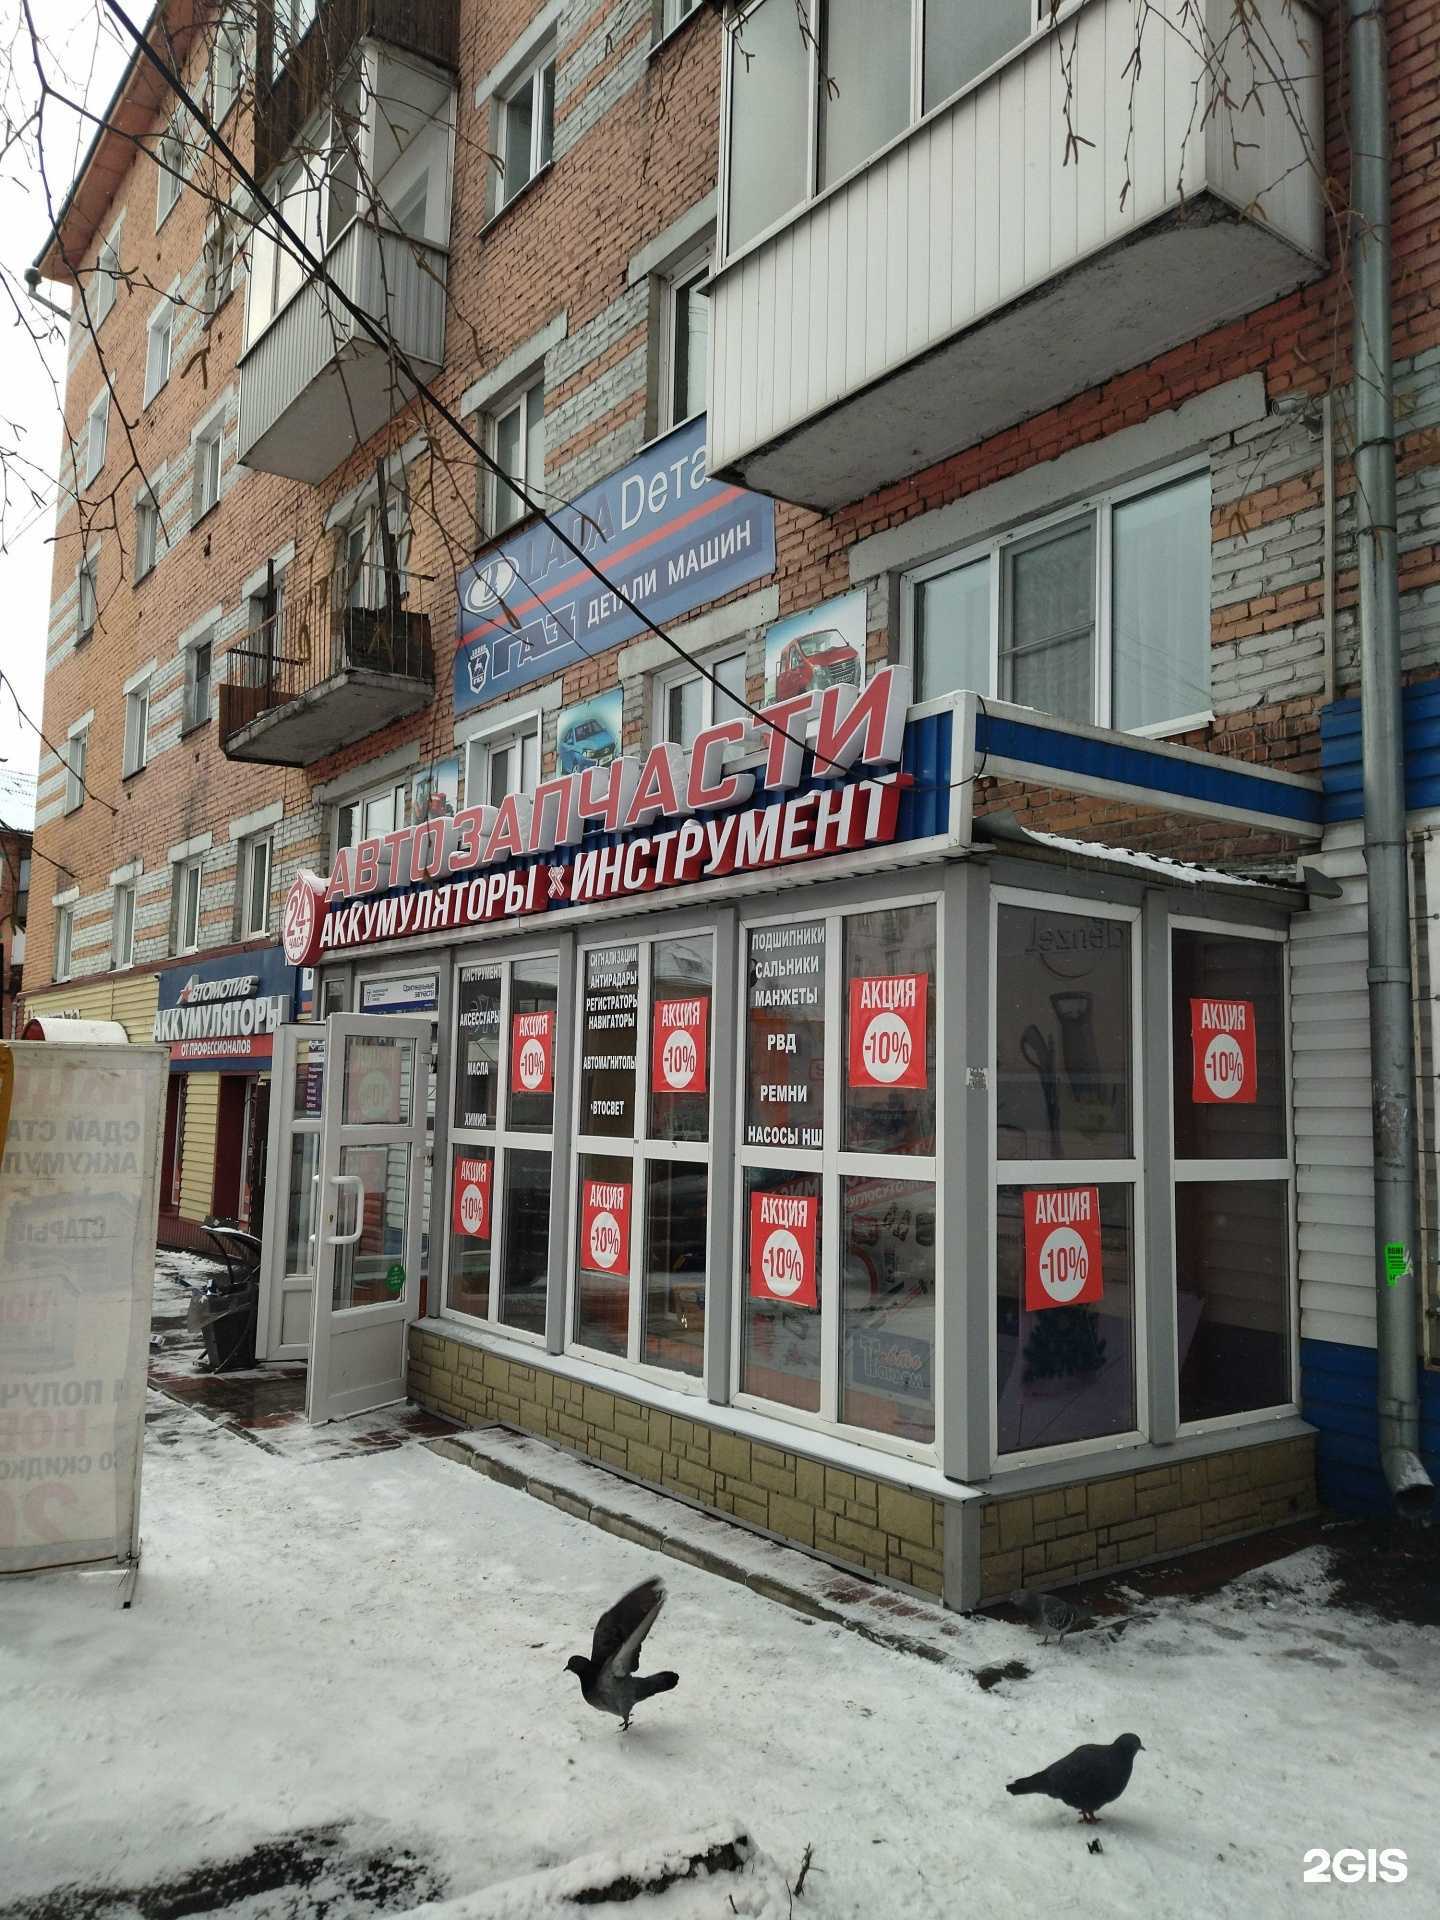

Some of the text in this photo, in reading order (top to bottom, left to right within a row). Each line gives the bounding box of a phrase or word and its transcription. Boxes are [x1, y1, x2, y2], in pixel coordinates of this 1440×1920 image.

[587, 520, 752, 628] ДЕТАЛИ МАШИН
[491, 602, 576, 680] ГАЗ
[325, 664, 905, 902] АВТОЗАПЧАСТИ
[320, 776, 902, 949] АККУМУЛЯТОРЫ ИНСТРУМЕНТ
[751, 926, 826, 952] ПОДШИПНИКИ
[590, 948, 638, 967] СИГНАЛИЗАЦИИ
[755, 955, 819, 978] САЛЬНИКИ
[590, 970, 638, 989] АНТИРАДАРЫ
[754, 987, 819, 1007] МАНЖЕТЫ
[860, 978, 917, 1011] АКЦИЯ
[153, 996, 284, 1042] АККУМУЛЯТОРЫ
[519, 1014, 548, 1037] АКЦИЯ
[588, 1013, 635, 1030] НАВИГАТОРЫ
[661, 1001, 701, 1028] АКЦИЯ
[1201, 1002, 1246, 1032] АКЦИЯ
[189, 1040, 251, 1056] ПРОФЕССИОНАЛОВ
[767, 1033, 797, 1054] РВД
[864, 1031, 910, 1064] -10%
[467, 1061, 489, 1076] МАСЛА
[520, 1051, 544, 1076] -10%
[664, 1046, 697, 1073] -10%
[1206, 1051, 1243, 1082] -10%
[760, 1085, 808, 1102] РЕМНИ
[464, 1112, 487, 1127] ХИМИЯ
[590, 1101, 625, 1115] ВТОСВЕТ
[748, 1126, 823, 1146] НАСОСЫ НШ
[461, 1161, 487, 1183] АКЦИЯ
[461, 1196, 483, 1222] -10%
[589, 1184, 624, 1211] АКЦИЯ
[1035, 1191, 1091, 1226] АКЦИЯ
[760, 1196, 808, 1229] АКЦИЯ
[591, 1226, 620, 1256] -10%
[763, 1246, 803, 1282] -10%
[1041, 1246, 1087, 1283] -10%
